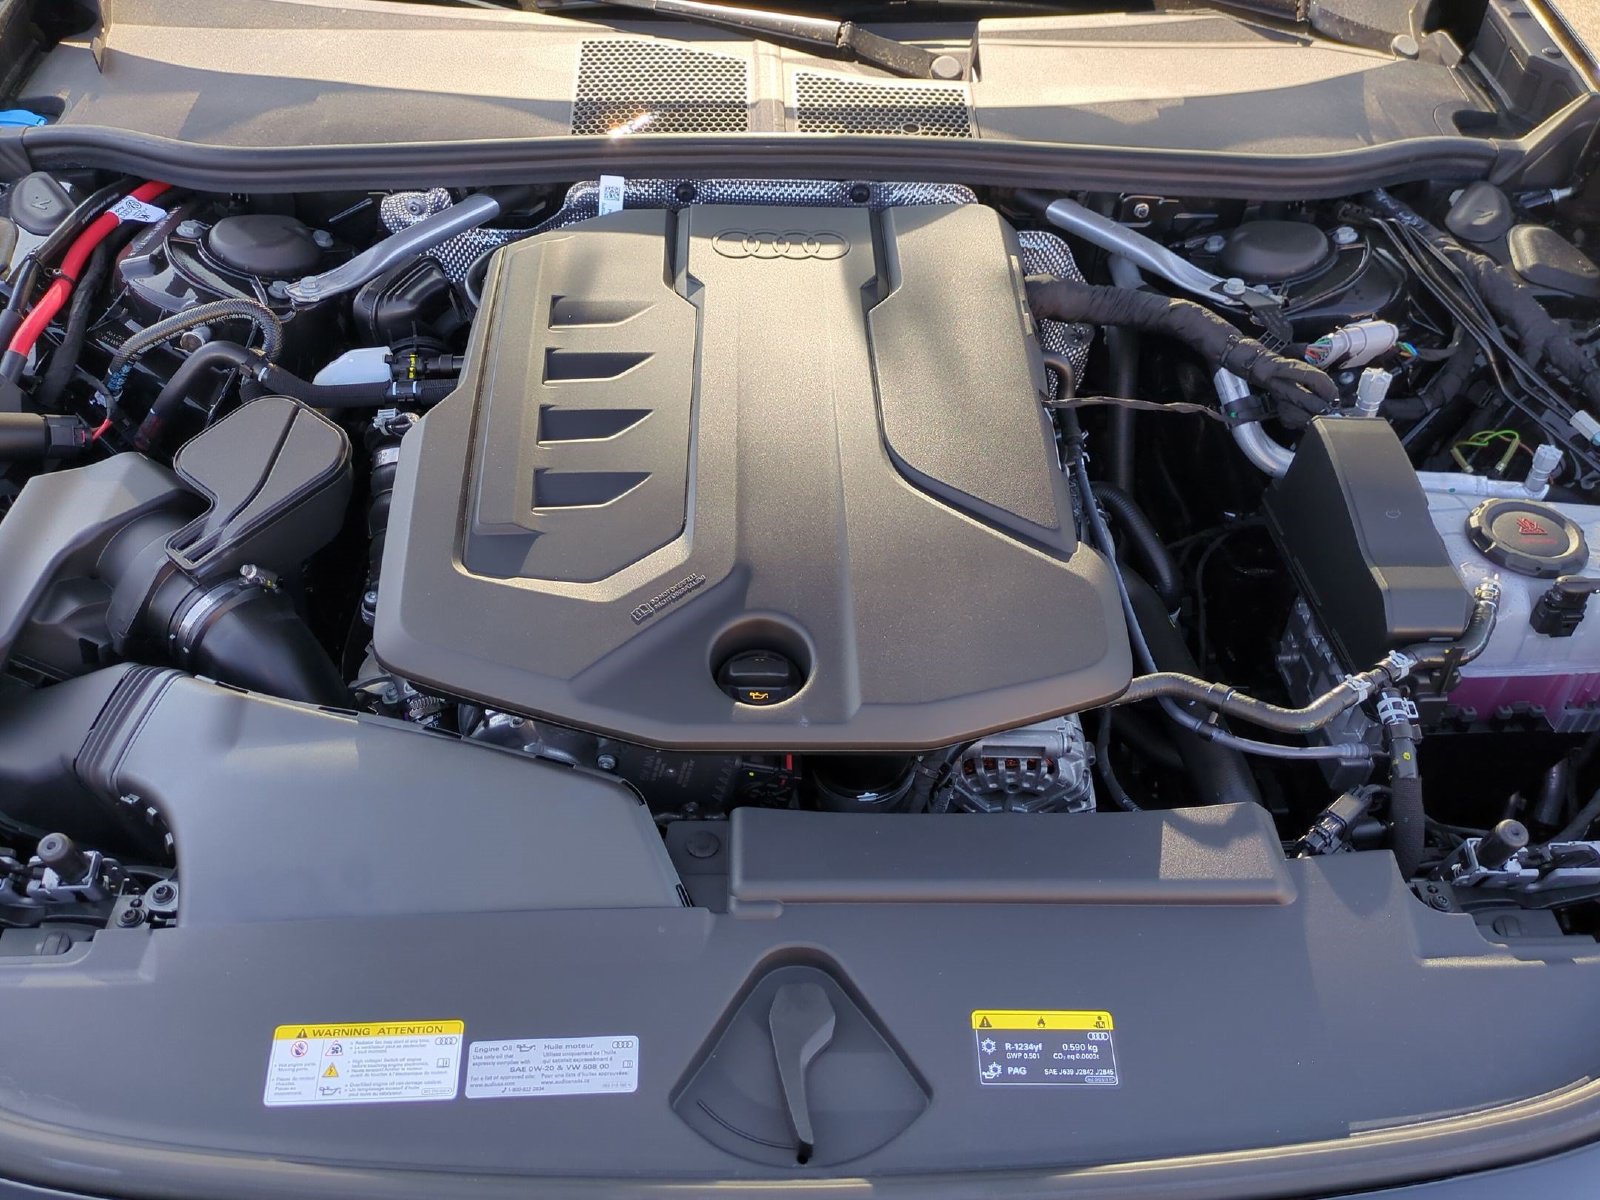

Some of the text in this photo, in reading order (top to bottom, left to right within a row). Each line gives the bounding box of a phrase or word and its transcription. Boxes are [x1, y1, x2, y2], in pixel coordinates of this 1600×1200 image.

[313, 1026, 443, 1037] WARNING ATTENTION
[1005, 1042, 1042, 1052] R-1234yf
[1088, 1043, 1098, 1053] kg
[1008, 1066, 1027, 1075] PAG
